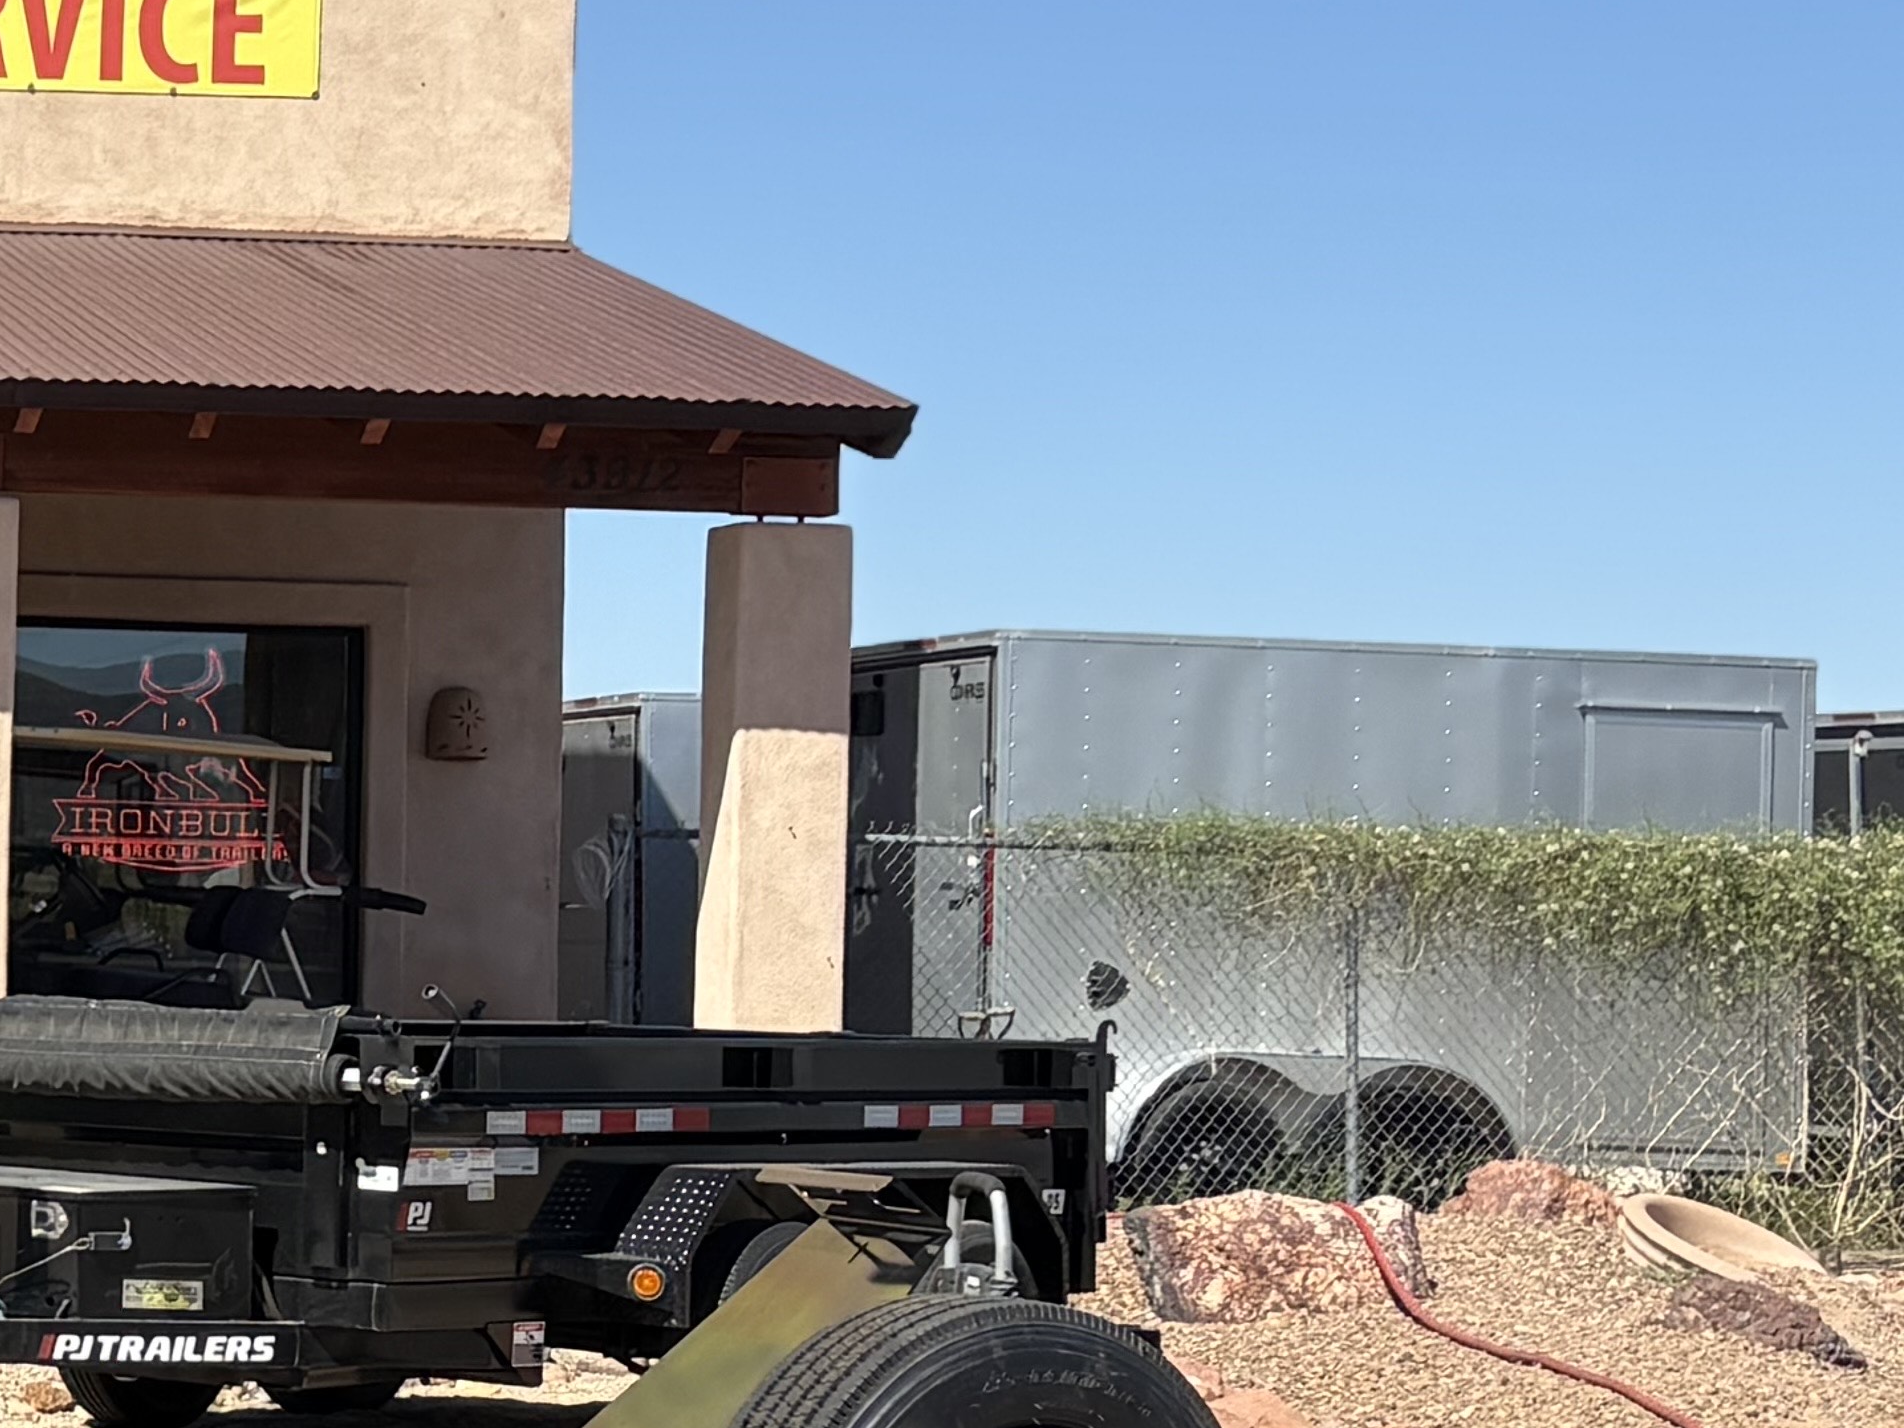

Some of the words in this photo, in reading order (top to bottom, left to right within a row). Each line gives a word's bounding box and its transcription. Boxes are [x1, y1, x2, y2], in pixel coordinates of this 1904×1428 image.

[407, 1201, 432, 1225] PJ
[52, 1333, 94, 1361] PJ
[97, 1334, 276, 1362] TRAILERS
